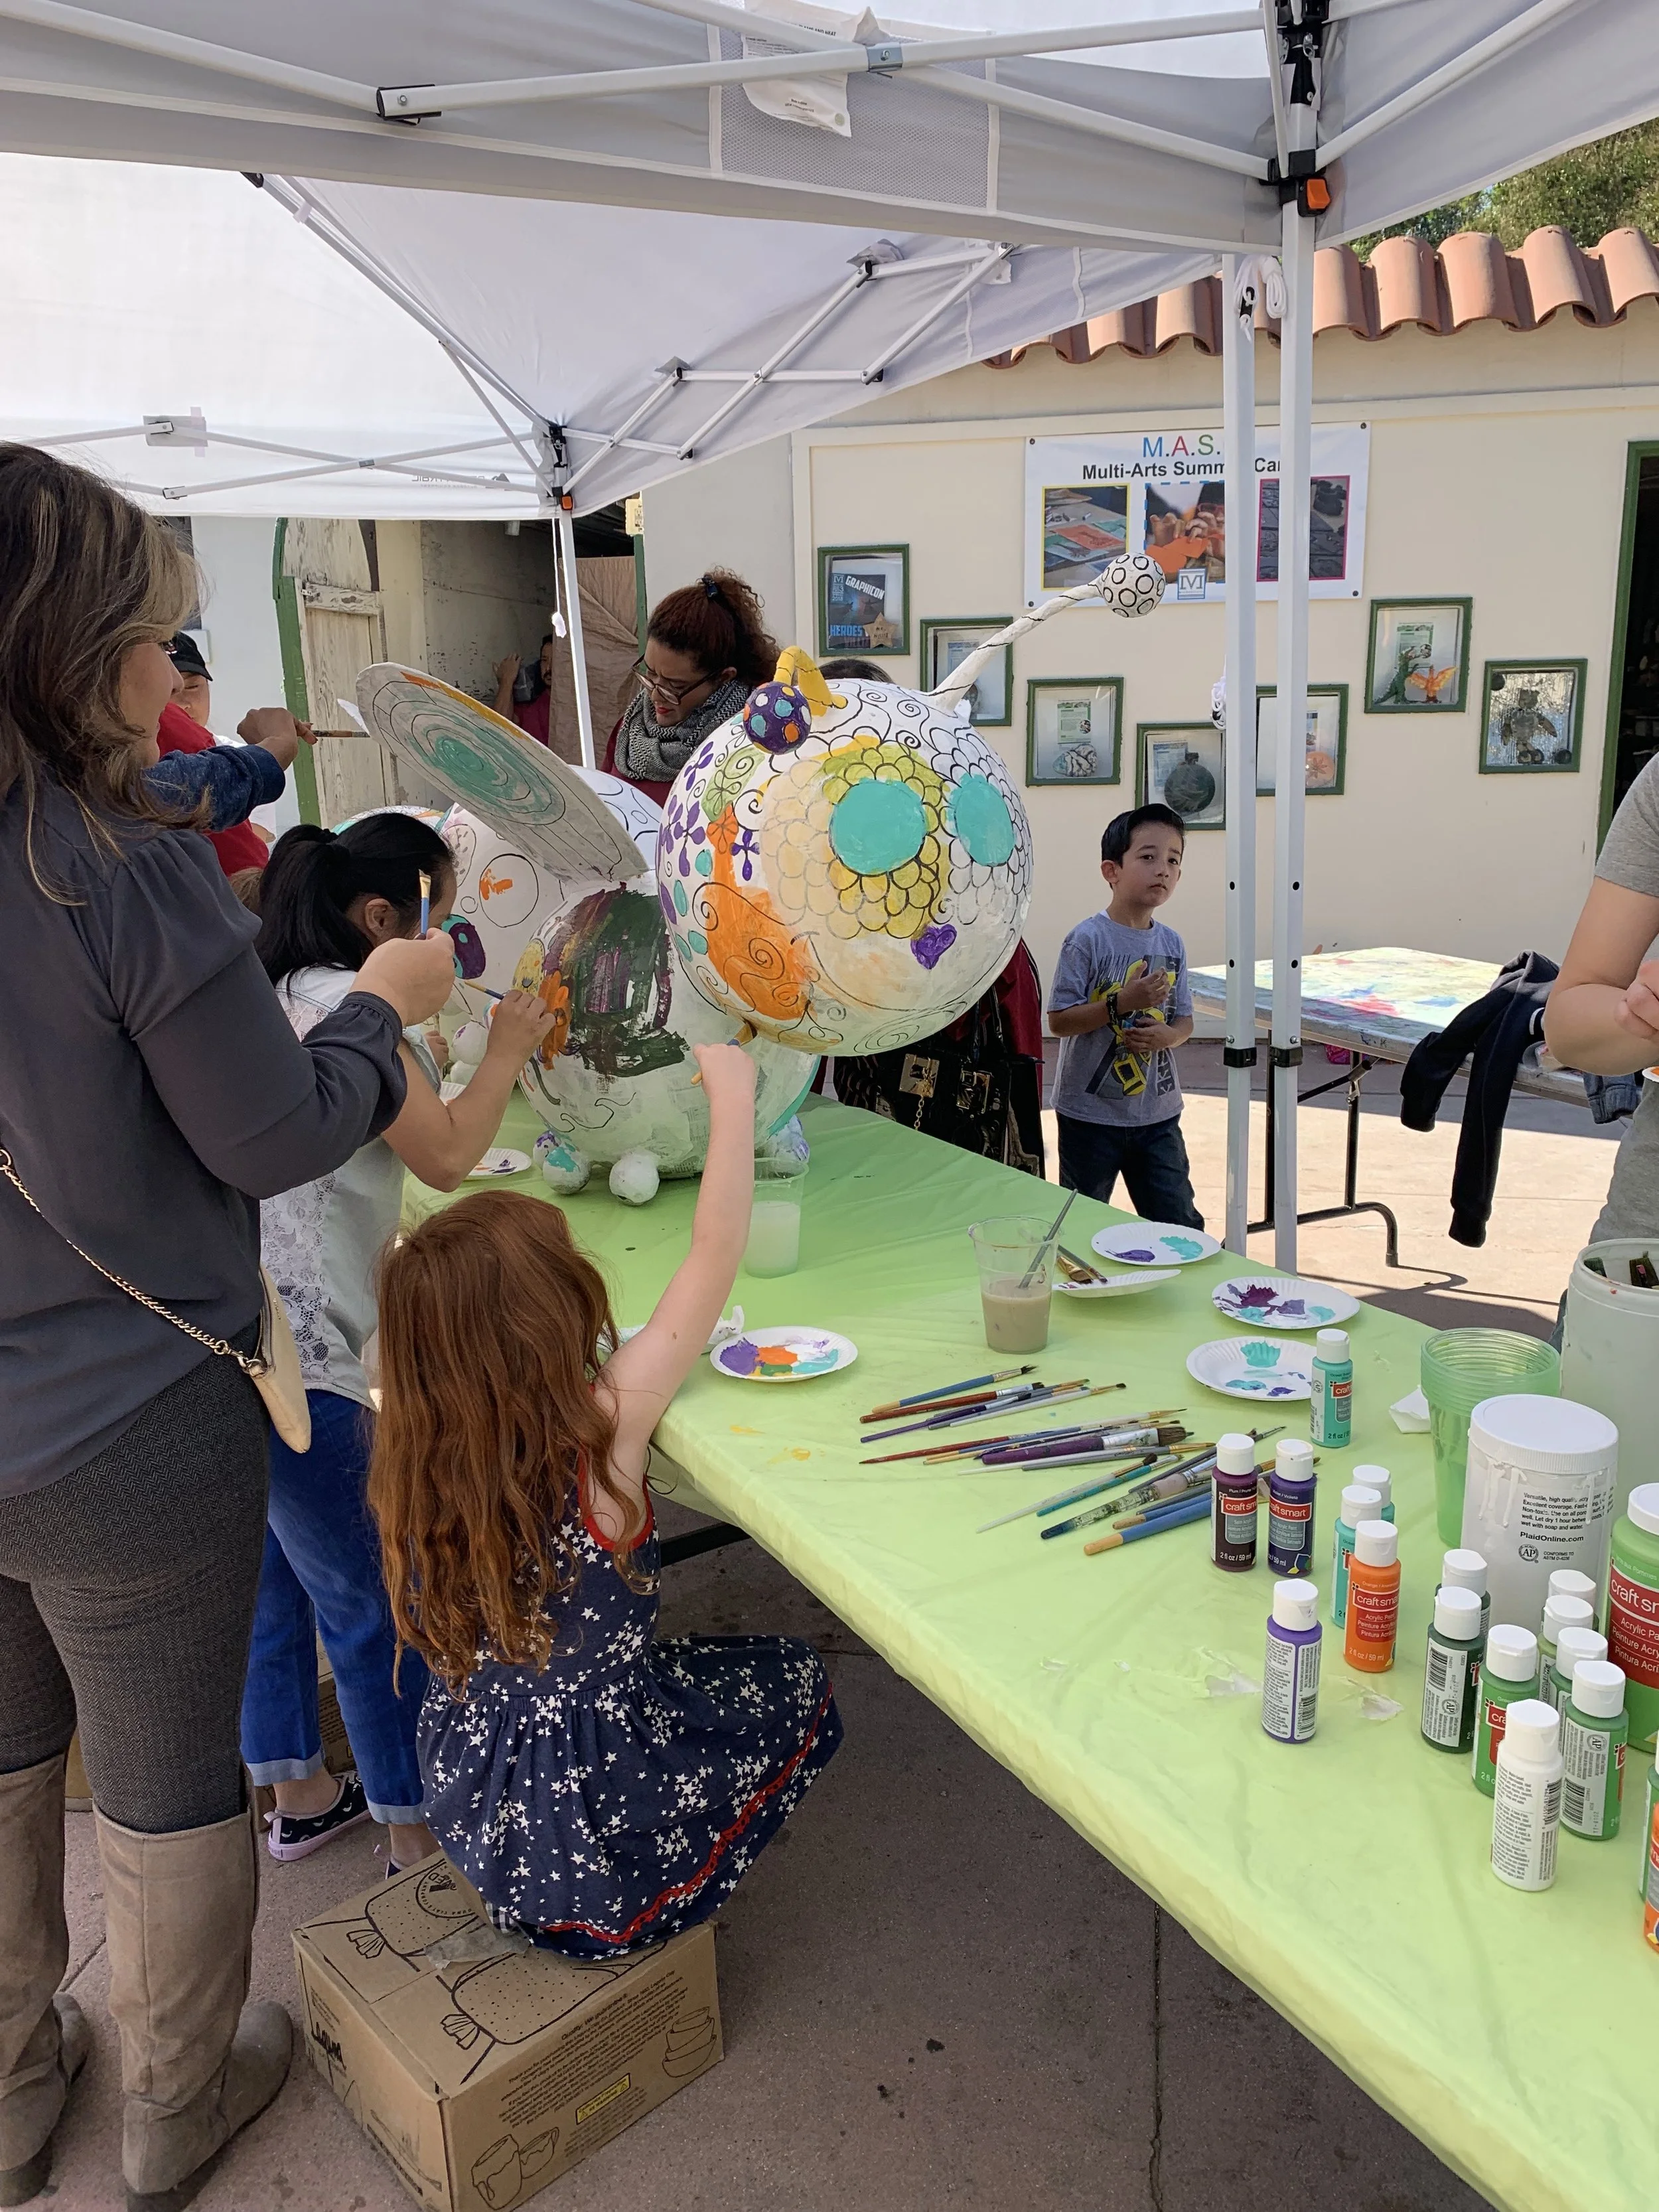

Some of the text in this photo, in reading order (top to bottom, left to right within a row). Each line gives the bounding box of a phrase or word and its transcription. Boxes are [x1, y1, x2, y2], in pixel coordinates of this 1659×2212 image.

[1143, 434, 1220, 458] M.A.S.
[1082, 457, 1280, 480] Multi-Arts Summ Ca
[845, 575, 885, 600] GRAPHICON
[1180, 575, 1202, 589] M
[830, 625, 863, 636] HEROES
[1226, 1503, 1246, 1511] craft
[1523, 1499, 1547, 1508] Excellent
[1520, 1531, 1584, 1542] PlaidOnline.com
[1523, 1548, 1536, 1557] AP
[1612, 1579, 1639, 1607] craft
[1356, 1595, 1399, 1607] craft sma
[1621, 1617, 1646, 1636] Acrylic
[1613, 1627, 1639, 1650] Peinture
[1615, 1645, 1639, 1666] Pintura
[1492, 1713, 1506, 1724] cra
[1593, 1737, 1602, 1750] AP
[1480, 1771, 1485, 1780] 2
